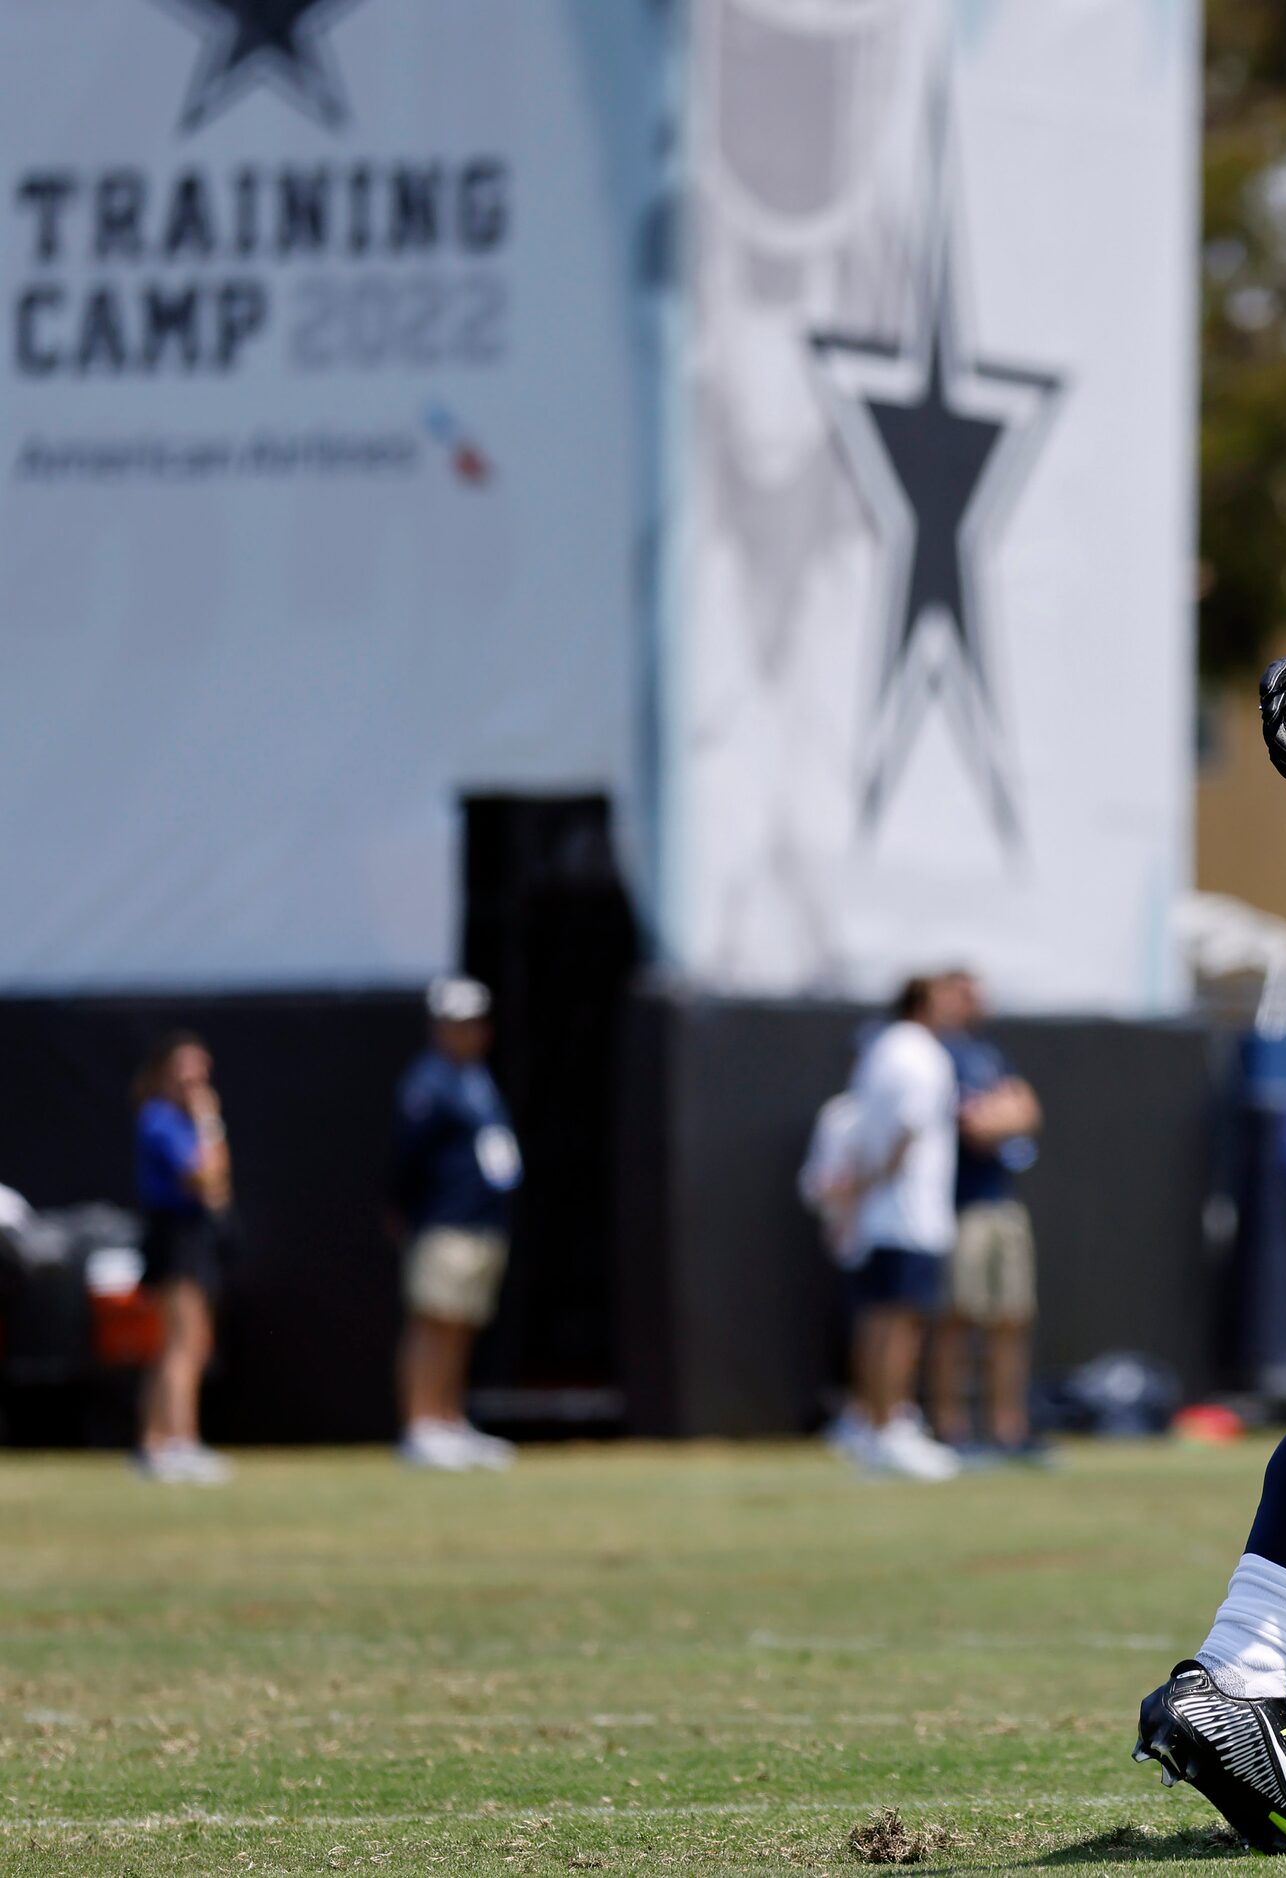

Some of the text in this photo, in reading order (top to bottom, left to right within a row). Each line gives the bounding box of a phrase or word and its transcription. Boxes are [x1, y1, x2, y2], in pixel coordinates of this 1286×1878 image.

[17, 158, 511, 264] TRAINING
[13, 271, 508, 376] CAMP 2022
